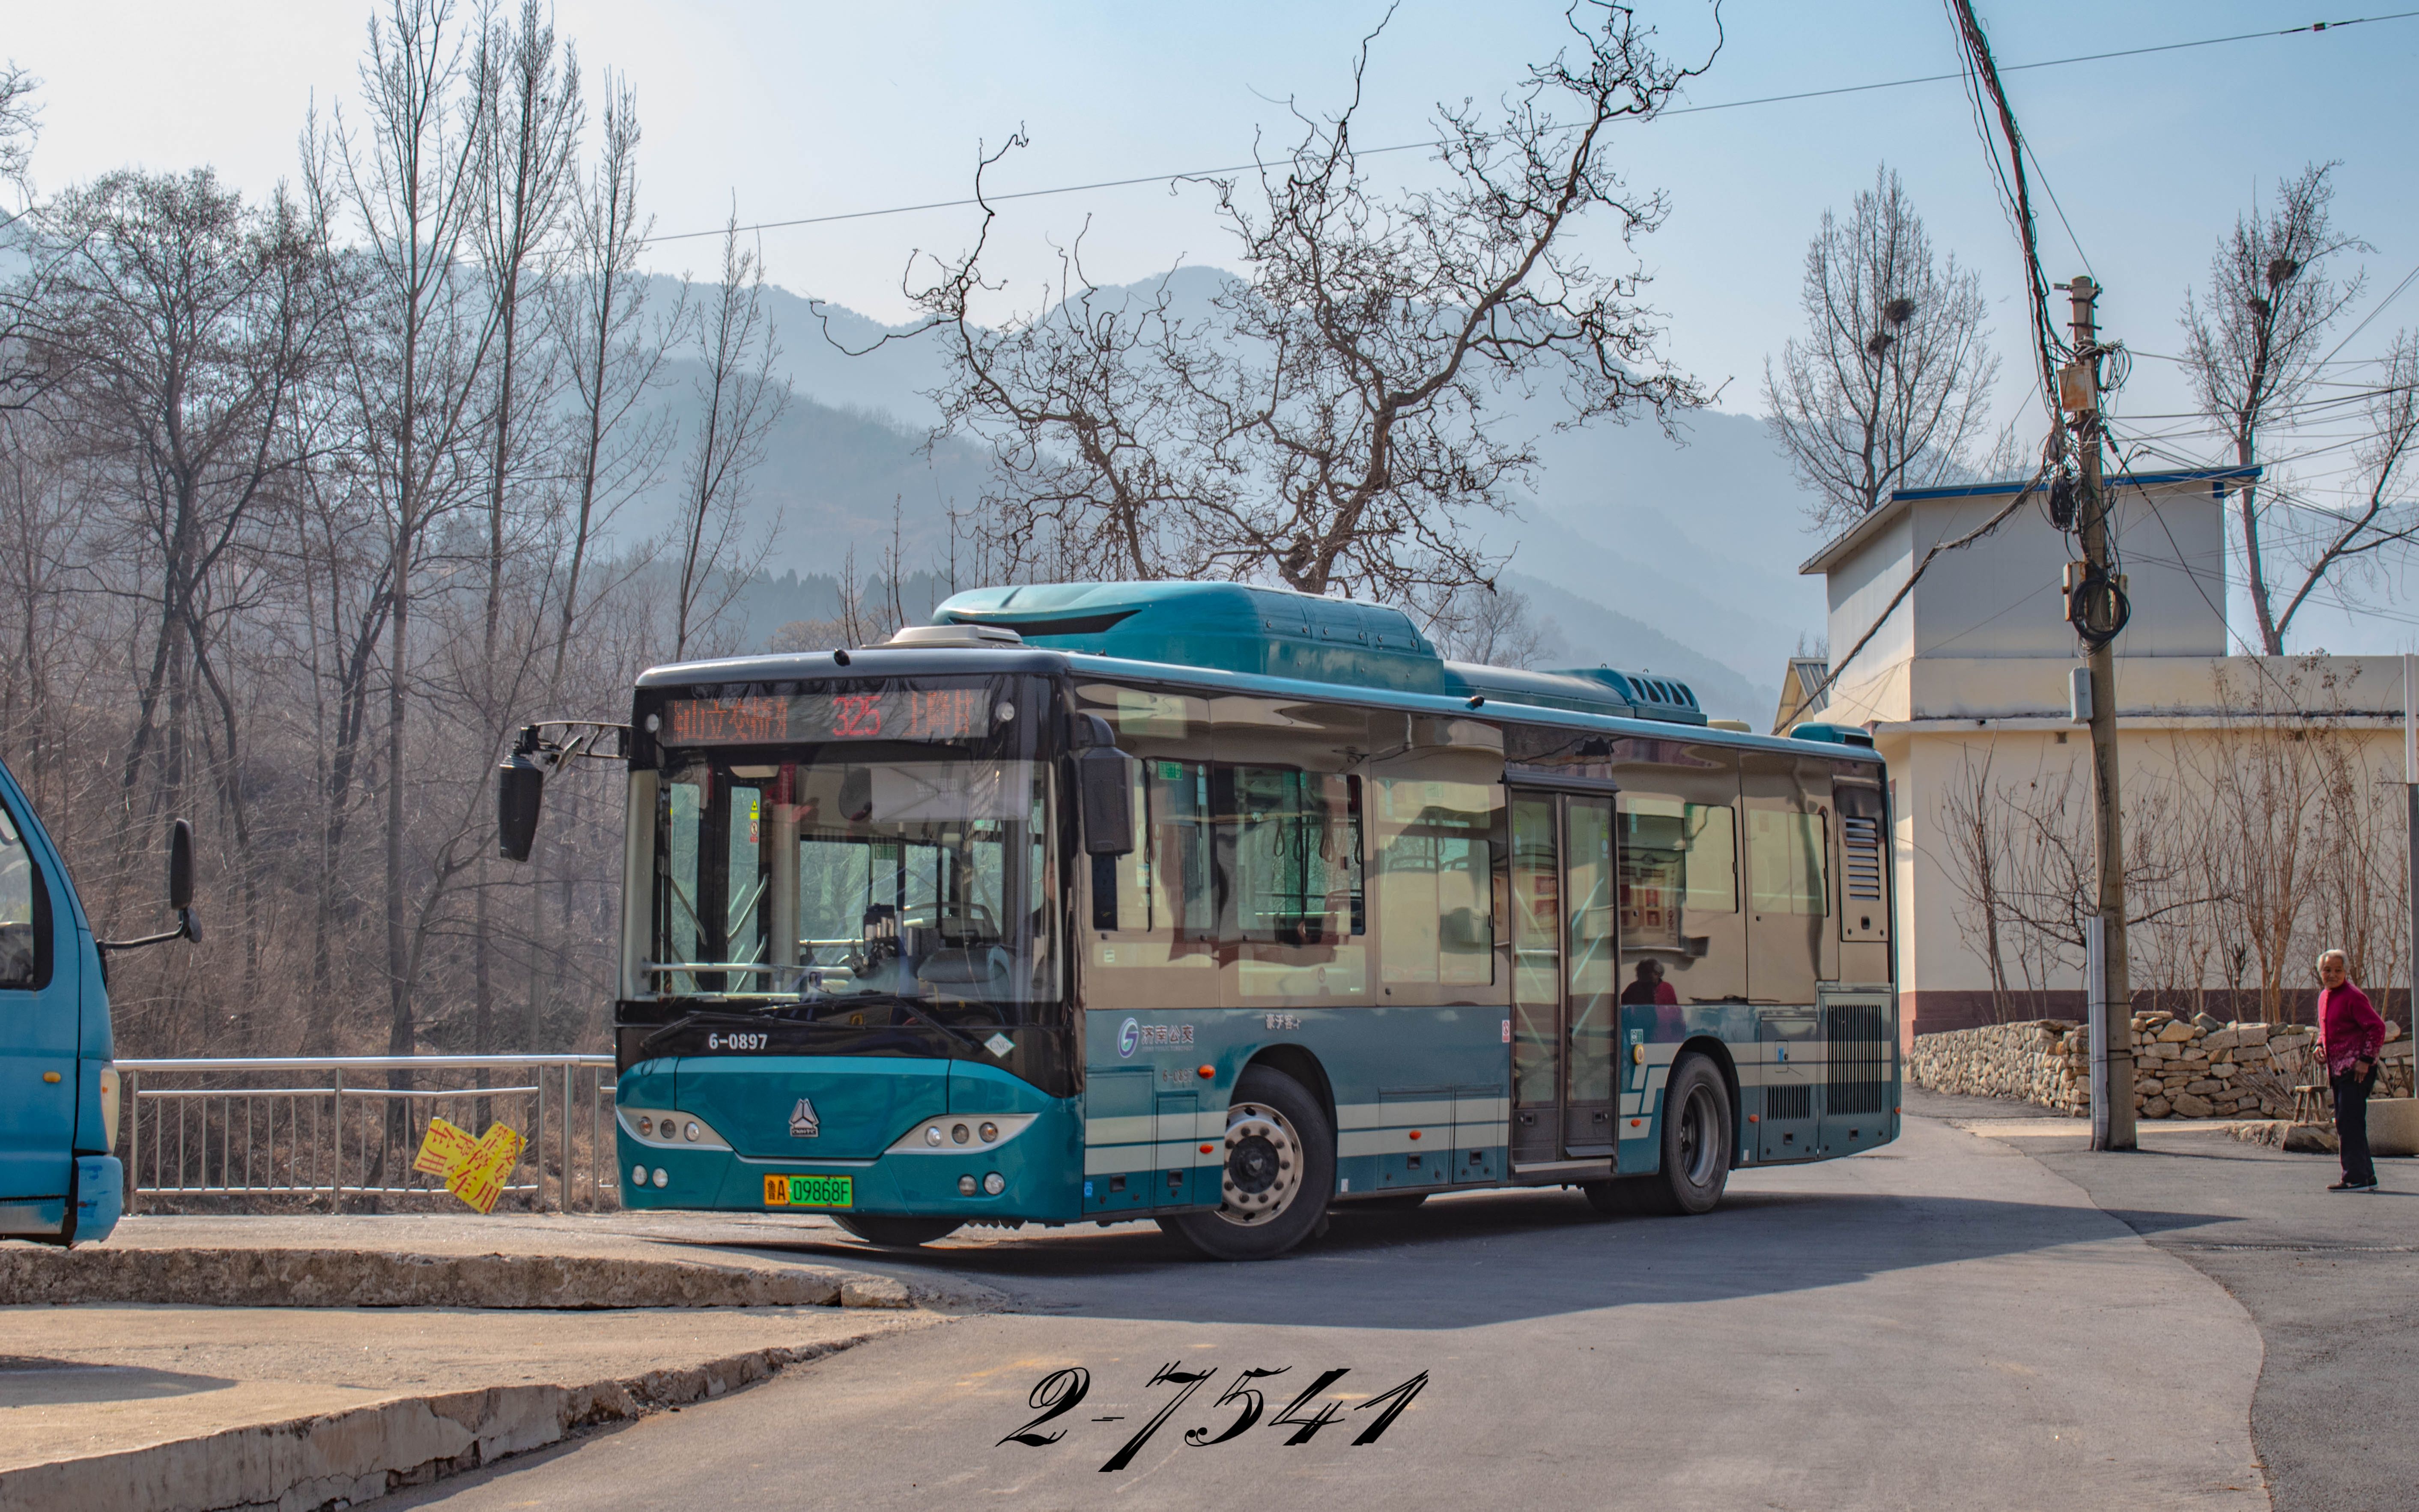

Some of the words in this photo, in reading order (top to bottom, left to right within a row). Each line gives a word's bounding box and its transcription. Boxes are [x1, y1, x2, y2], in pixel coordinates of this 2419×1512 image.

[832, 695, 881, 736] 325
[709, 1033, 768, 1050] 6-0897
[1141, 1024, 1194, 1045] 济南公交
[990, 1040, 1009, 1051] CNG
[1162, 1068, 1194, 1083] 6-0897
